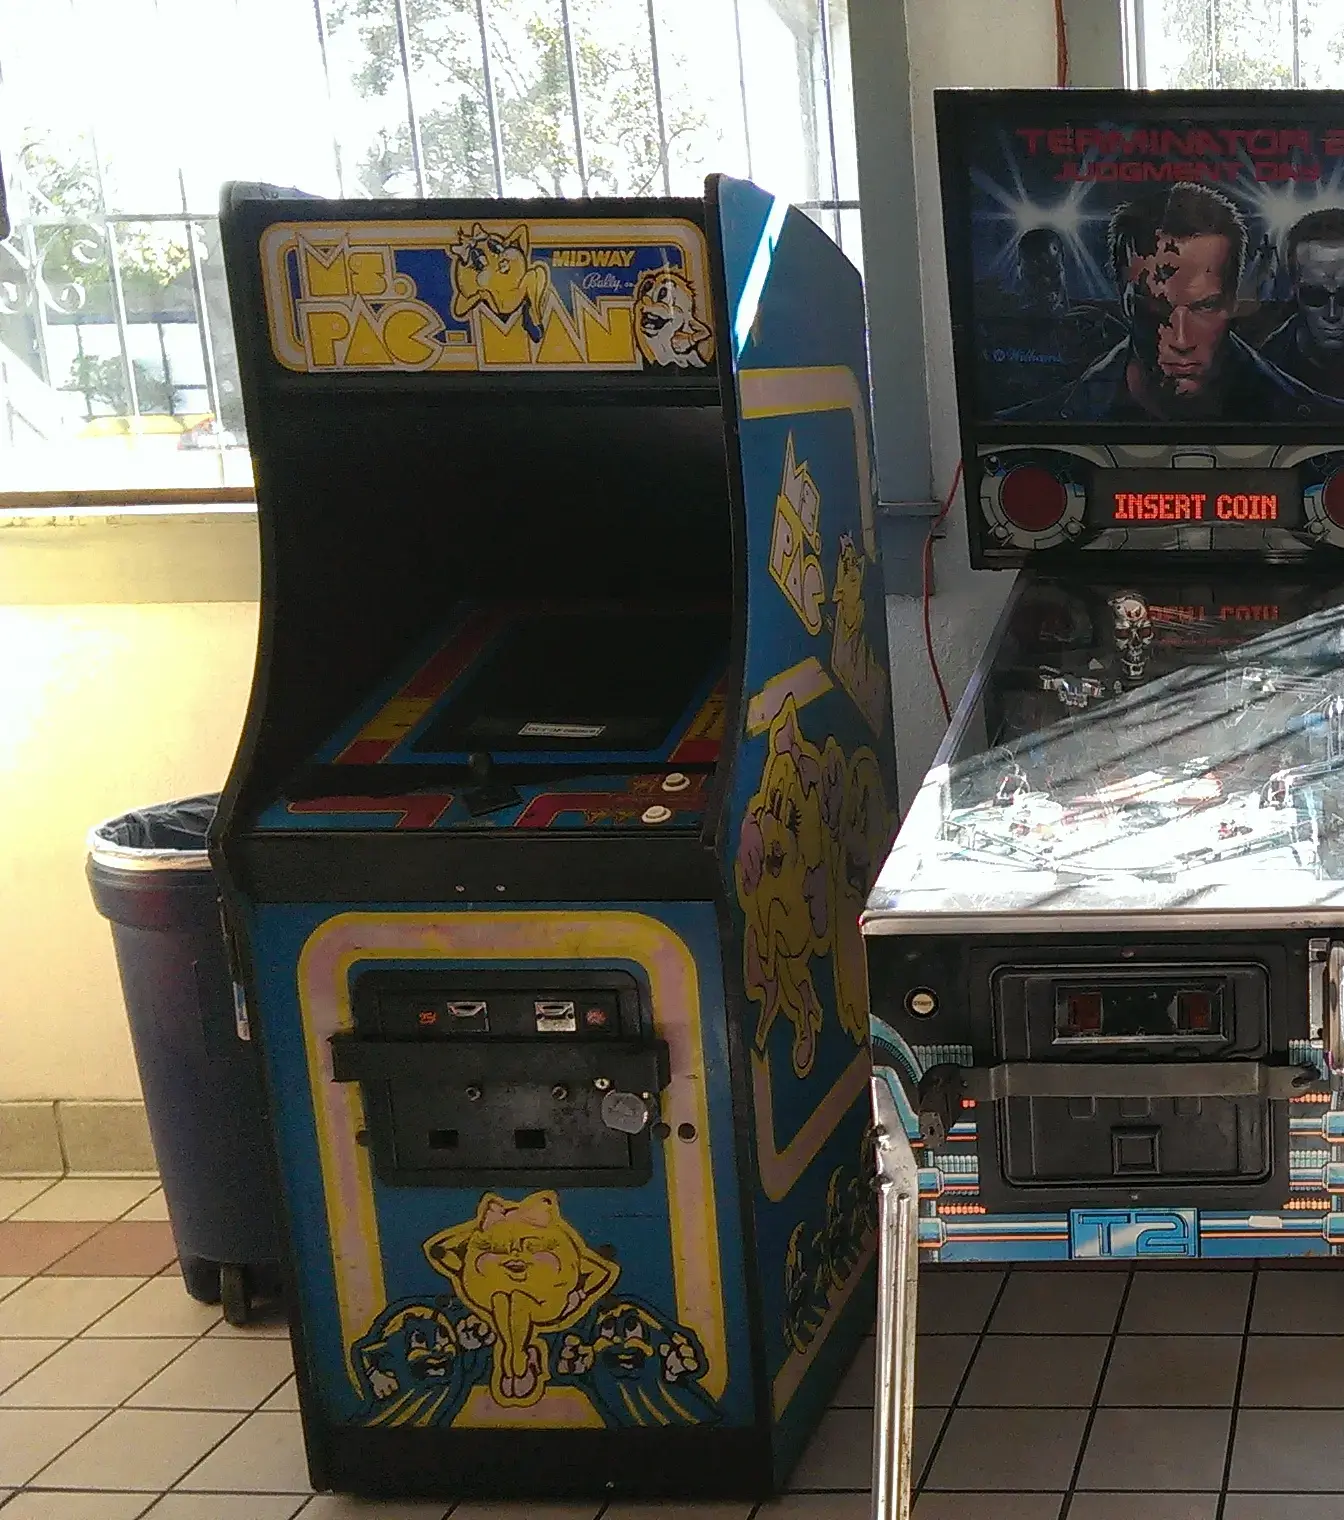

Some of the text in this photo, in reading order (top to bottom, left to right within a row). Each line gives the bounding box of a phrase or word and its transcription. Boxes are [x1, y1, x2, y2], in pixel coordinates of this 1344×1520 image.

[1016, 128, 1309, 155] TERMINATOR
[1054, 162, 1321, 182] JUDGMENT DAY
[300, 235, 417, 300] MS.
[552, 250, 636, 267] MIDWAY
[304, 290, 643, 371] PAC-MAN
[1114, 493, 1278, 520] INSERT COIN
[1076, 1212, 1190, 1257] T2
